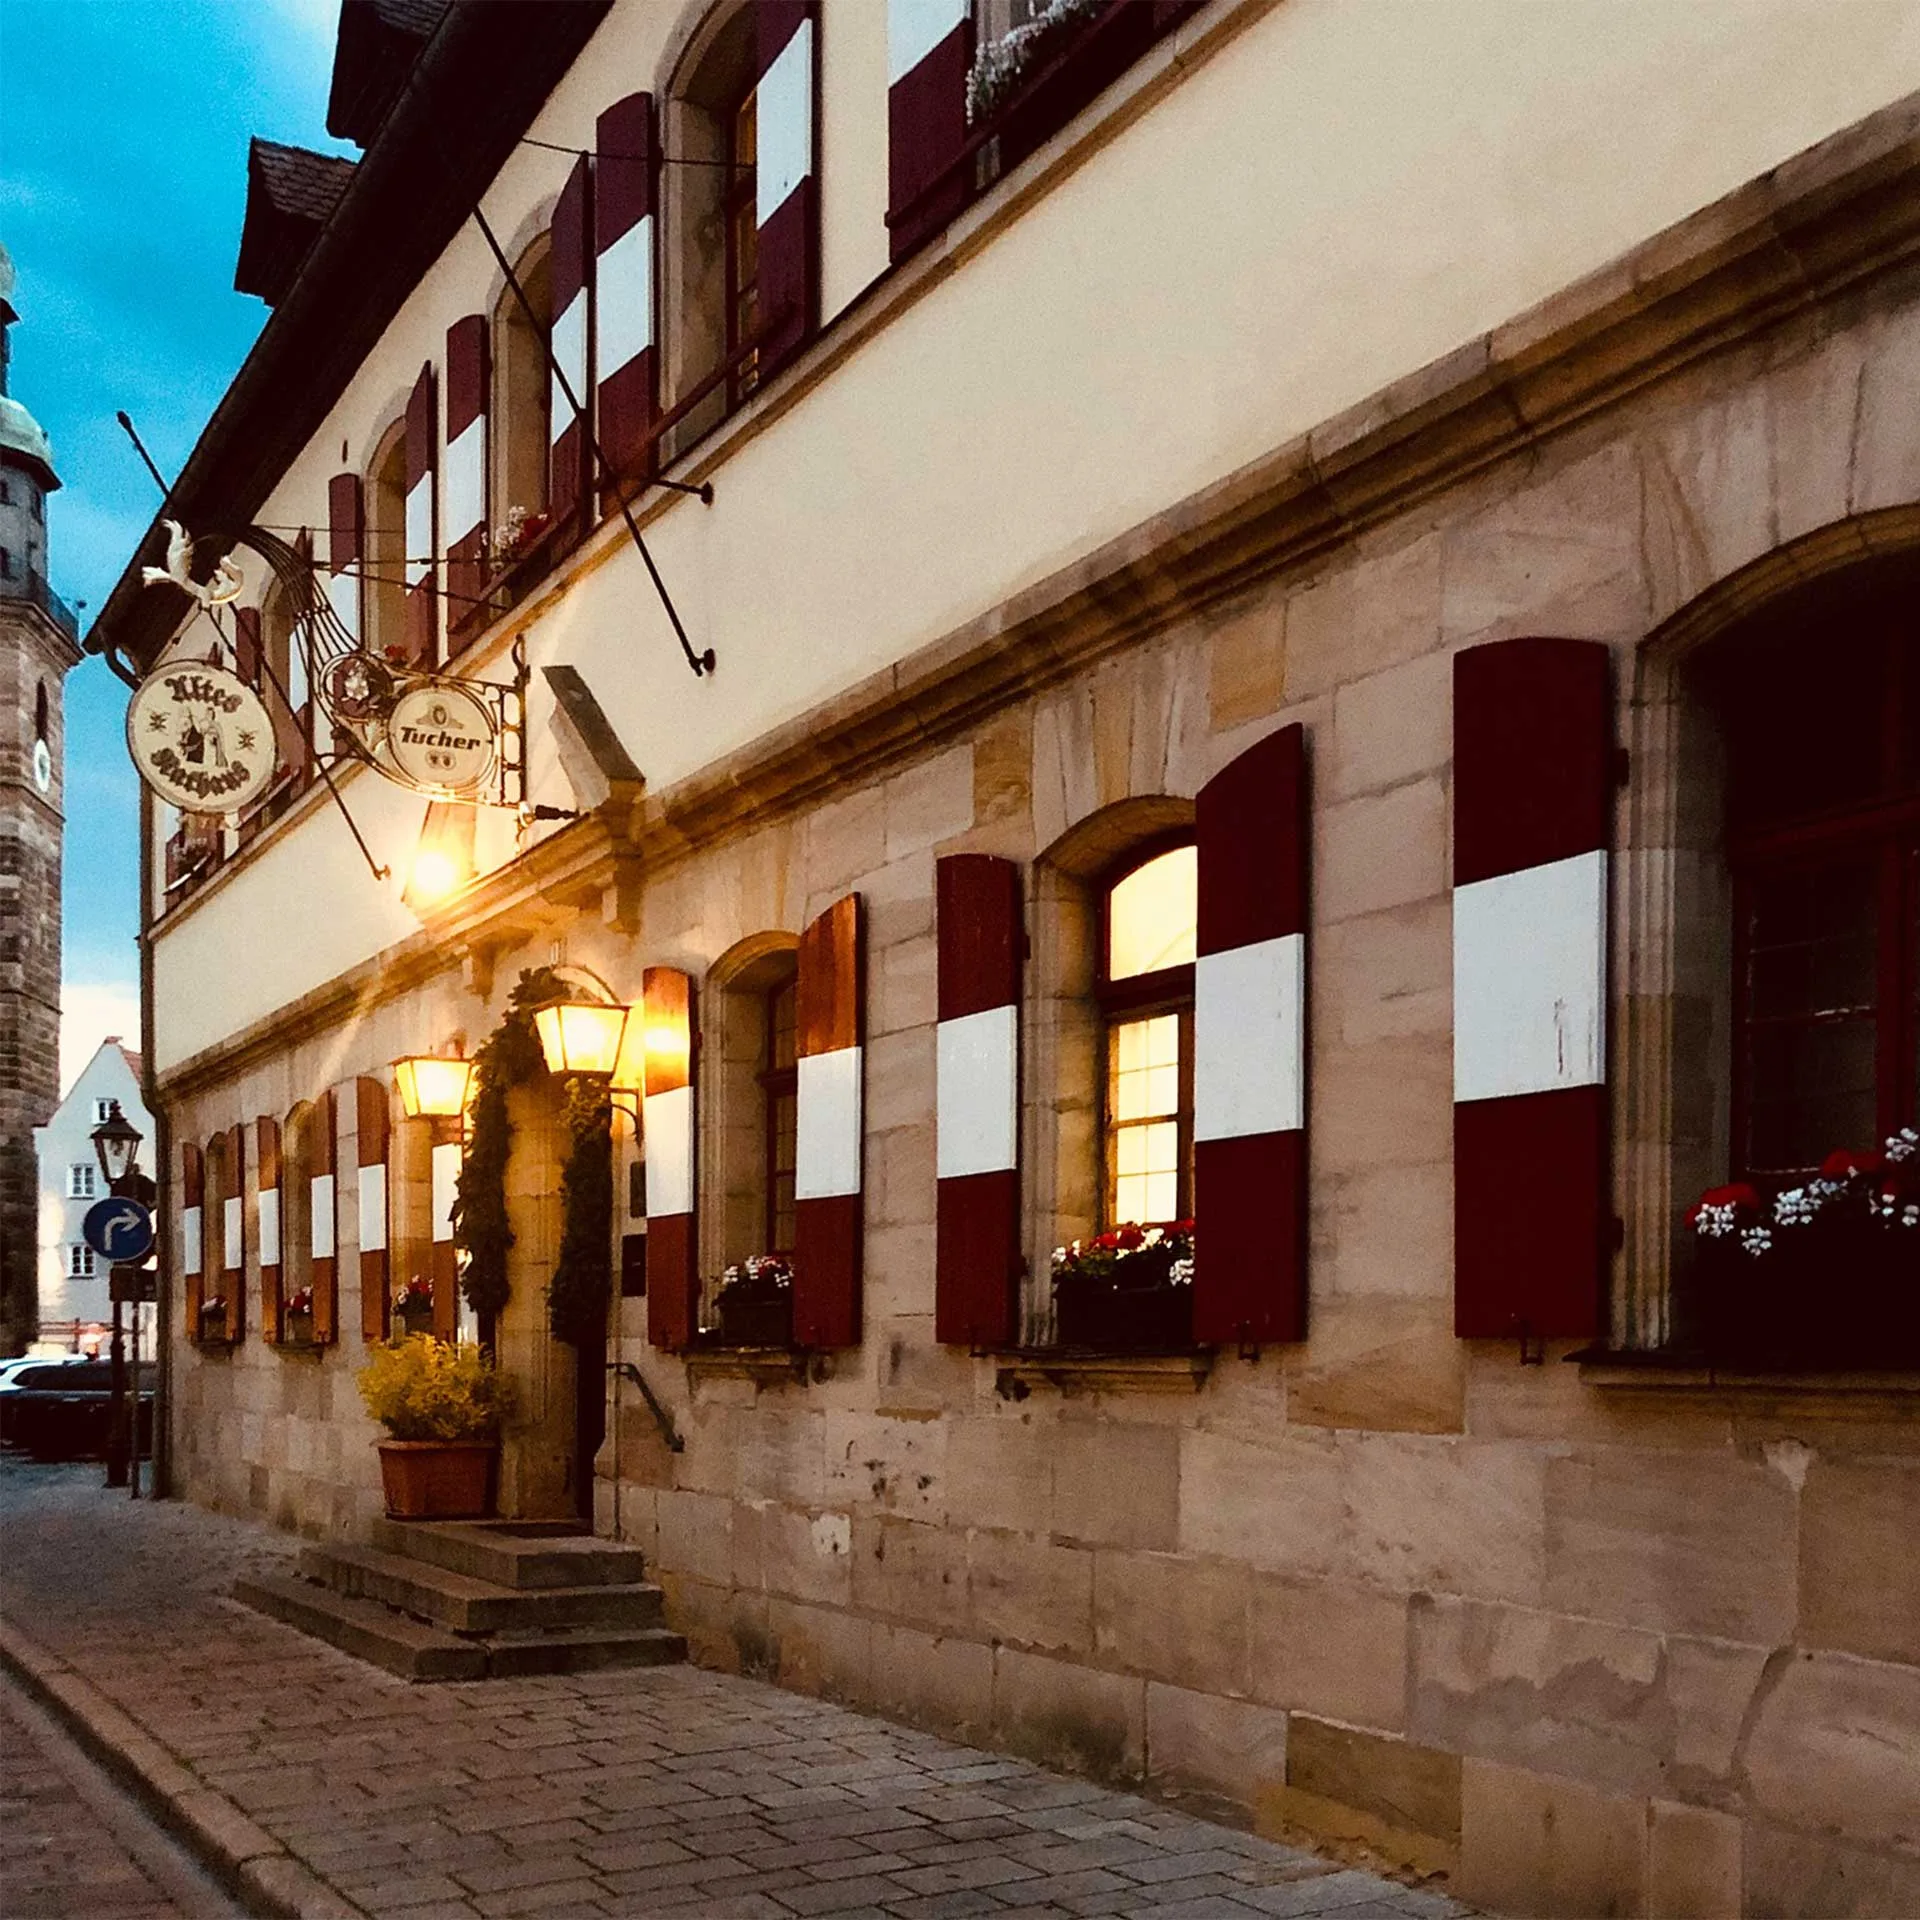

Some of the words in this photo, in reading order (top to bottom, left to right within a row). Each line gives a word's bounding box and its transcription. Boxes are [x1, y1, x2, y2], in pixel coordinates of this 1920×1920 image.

[164, 675, 244, 713] Altes
[400, 726, 481, 750] Tucher
[150, 747, 251, 799] Rathaus
